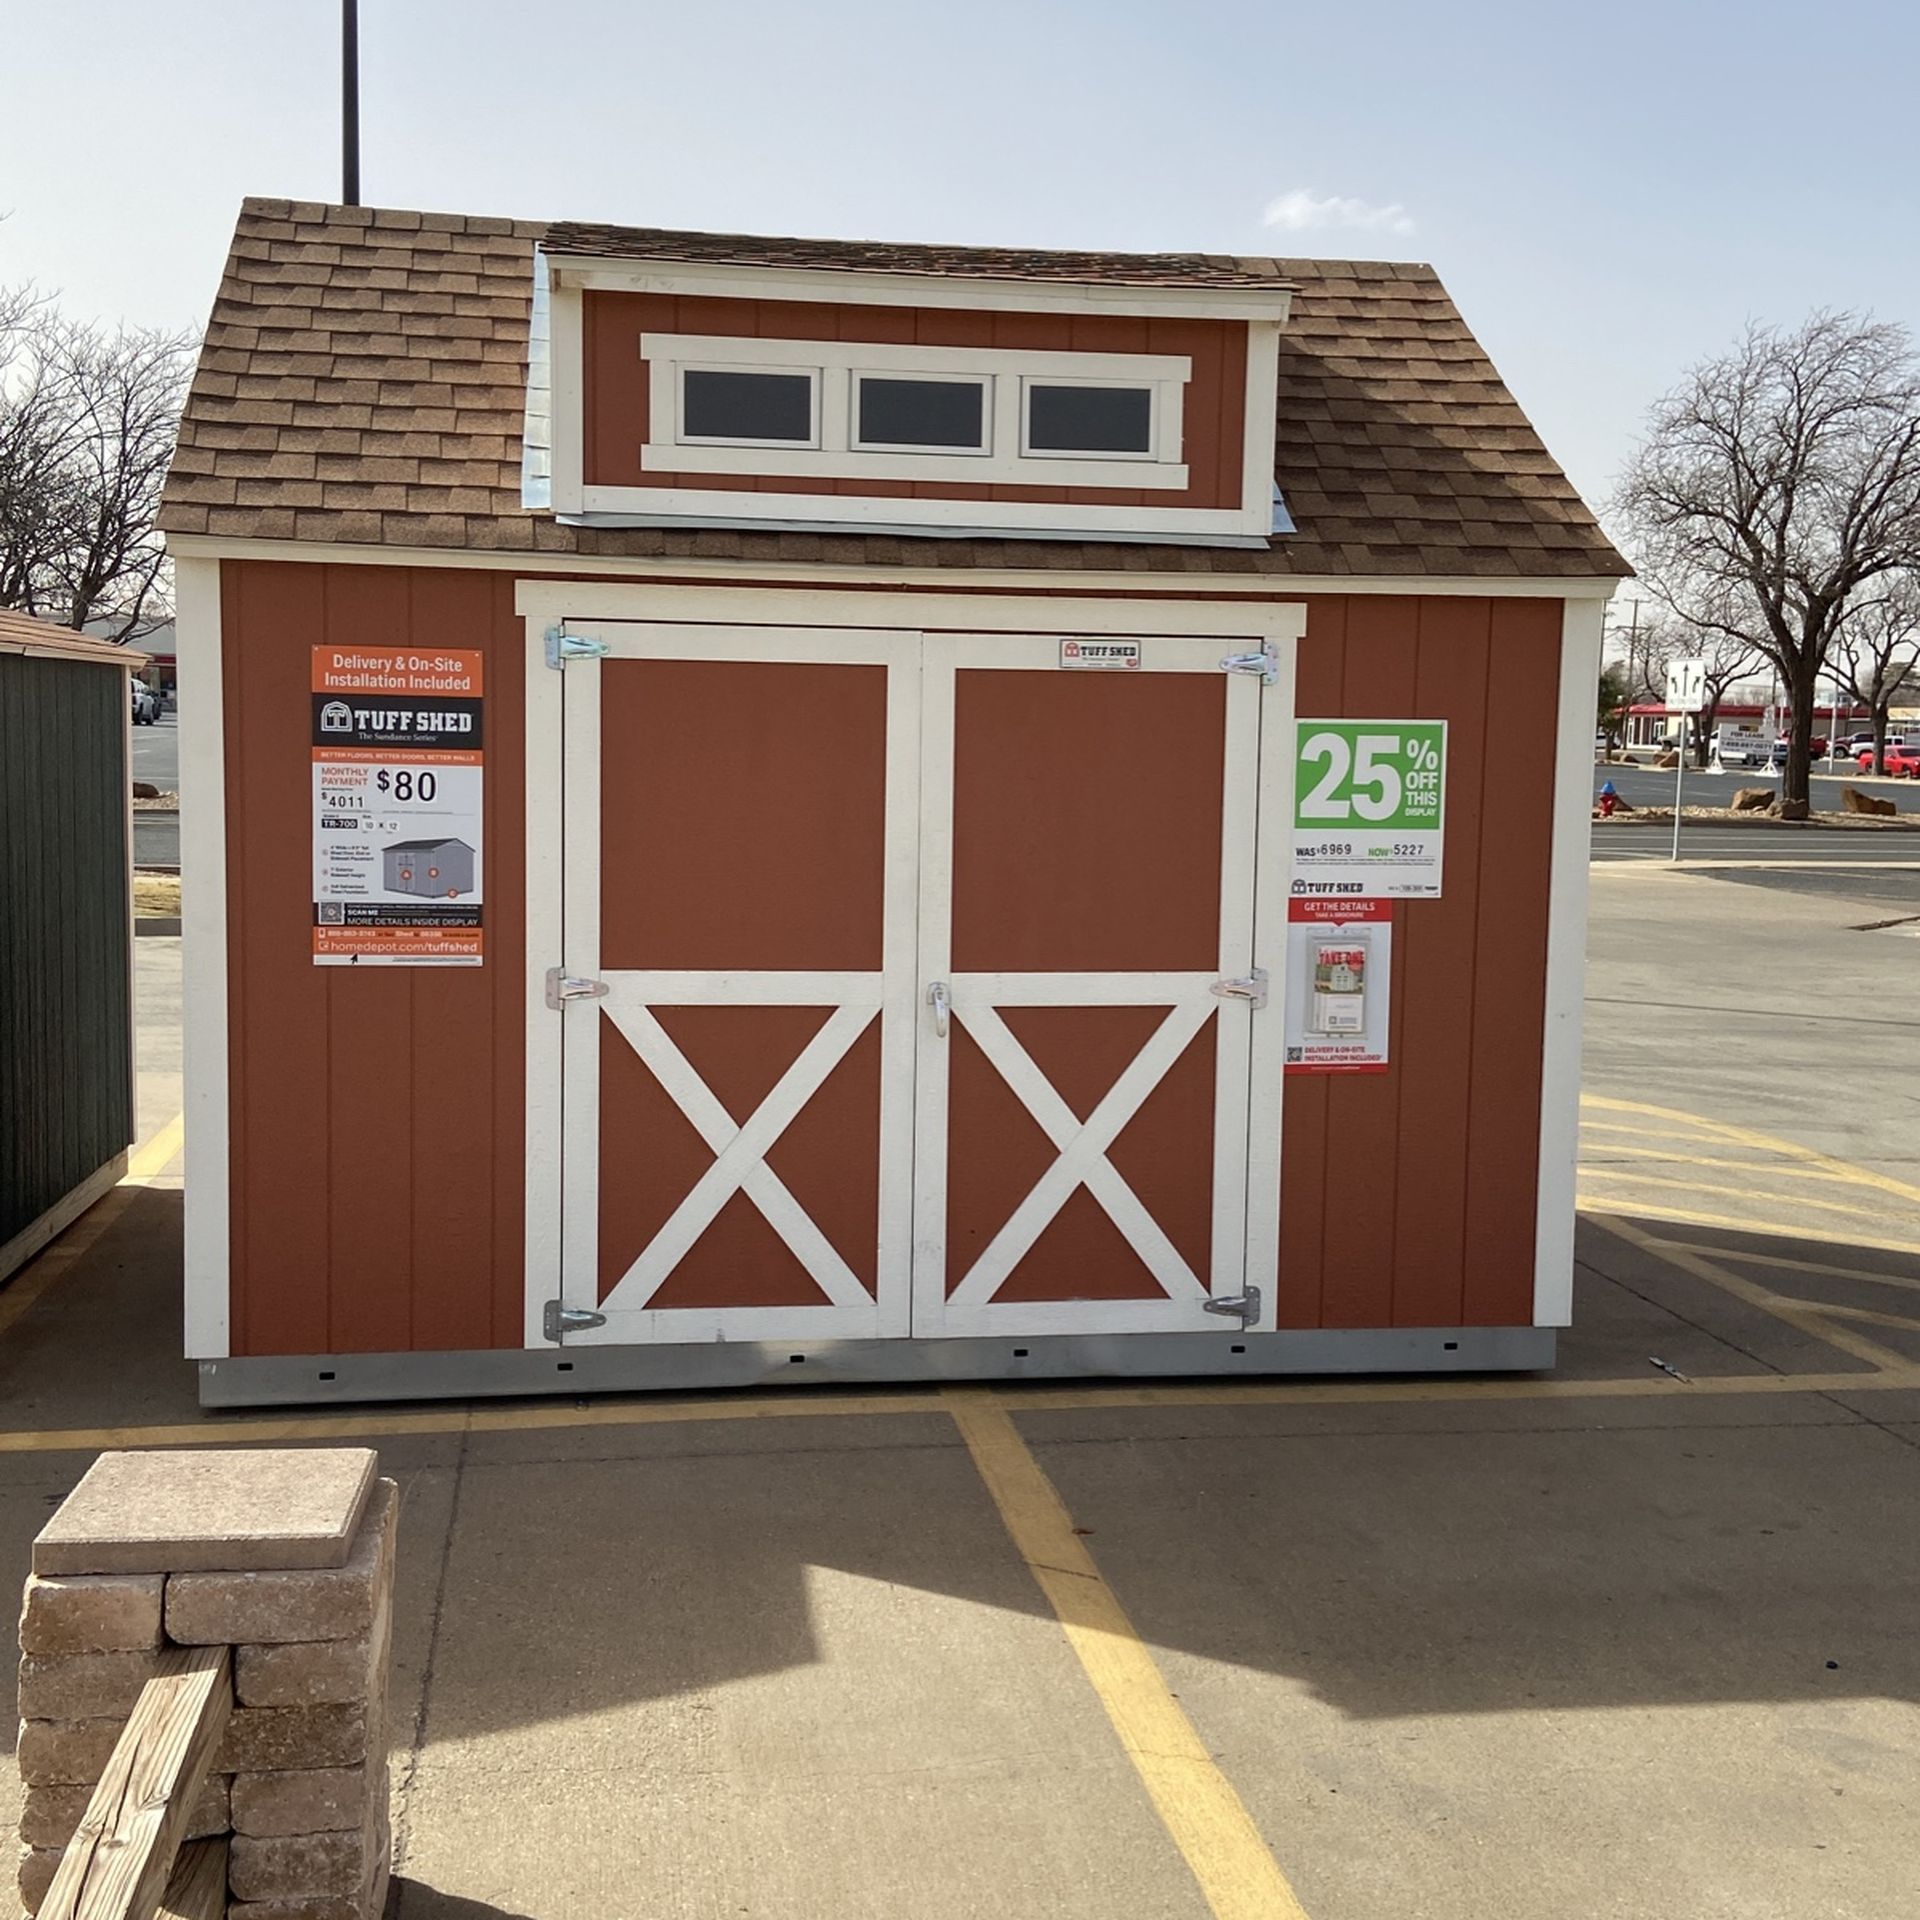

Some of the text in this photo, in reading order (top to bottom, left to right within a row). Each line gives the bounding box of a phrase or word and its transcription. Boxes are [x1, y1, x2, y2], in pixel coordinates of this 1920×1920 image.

[1081, 646, 1136, 656] TUFF SHED
[333, 654, 462, 673] Delivery & On-Site
[325, 673, 471, 690] Installation Included
[354, 710, 472, 732] TUFF SHED
[358, 732, 437, 742] The Sundance Series
[321, 767, 368, 776] MONTHLY
[1300, 732, 1438, 821] 25 %
[321, 777, 368, 786] PAYMENT
[1406, 772, 1438, 790] OFF
[1406, 791, 1438, 806] THIS
[1405, 807, 1436, 816] DISPLAY
[324, 820, 357, 828] TR-700
[1296, 847, 1316, 857] WAS
[1368, 848, 1389, 857] NOW
[1307, 882, 1364, 893] TUFF SHED
[1304, 902, 1375, 911] GET THE DETAILS
[442, 918, 478, 926] DISPLAY
[331, 940, 478, 953] homedepot.com/tuffshed
